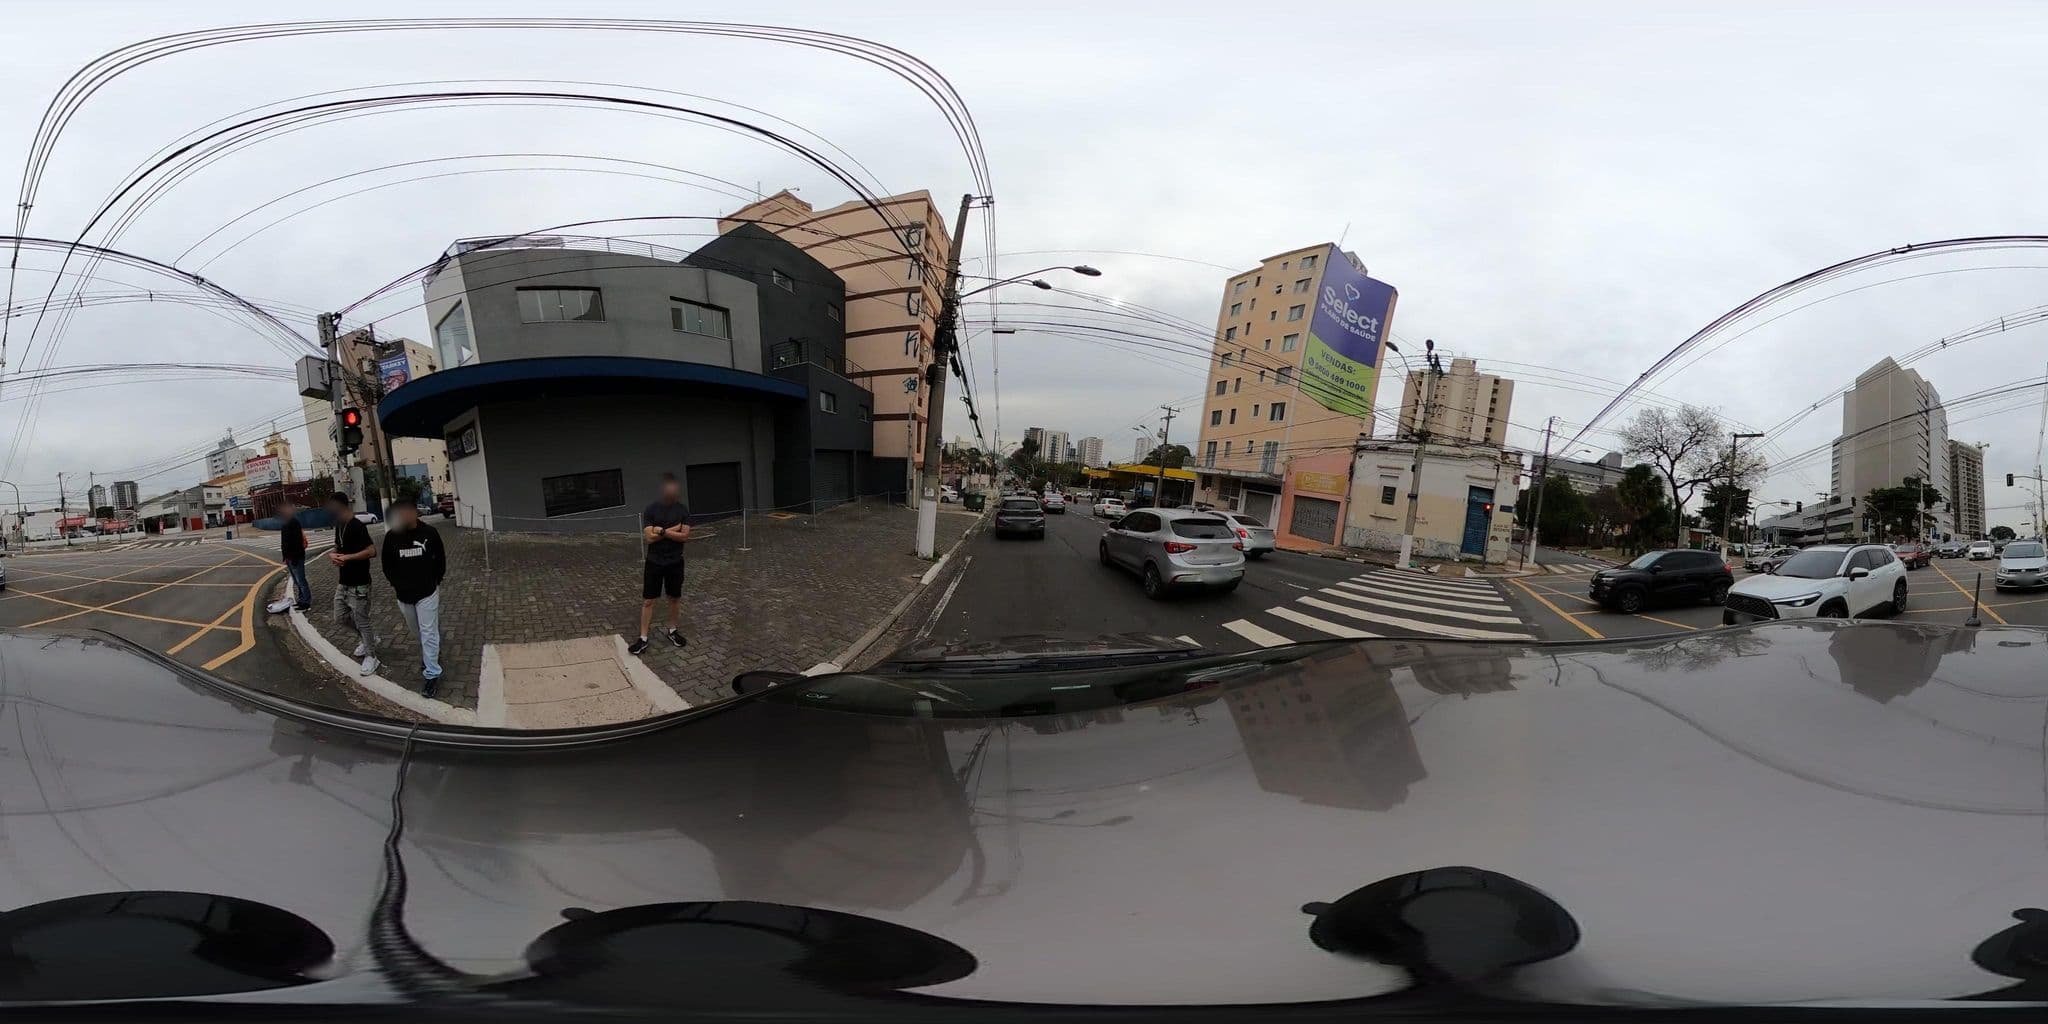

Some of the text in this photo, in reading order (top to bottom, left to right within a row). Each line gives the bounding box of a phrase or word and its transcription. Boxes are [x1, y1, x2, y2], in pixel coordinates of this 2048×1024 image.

[1321, 303, 1340, 323] PLANO
[1340, 319, 1349, 330] DE
[1324, 286, 1378, 333] Select
[1321, 350, 1356, 375] VENDAS:
[1330, 374, 1344, 385] 489
[1346, 380, 1366, 392] 1000
[399, 547, 422, 558] PUMA
